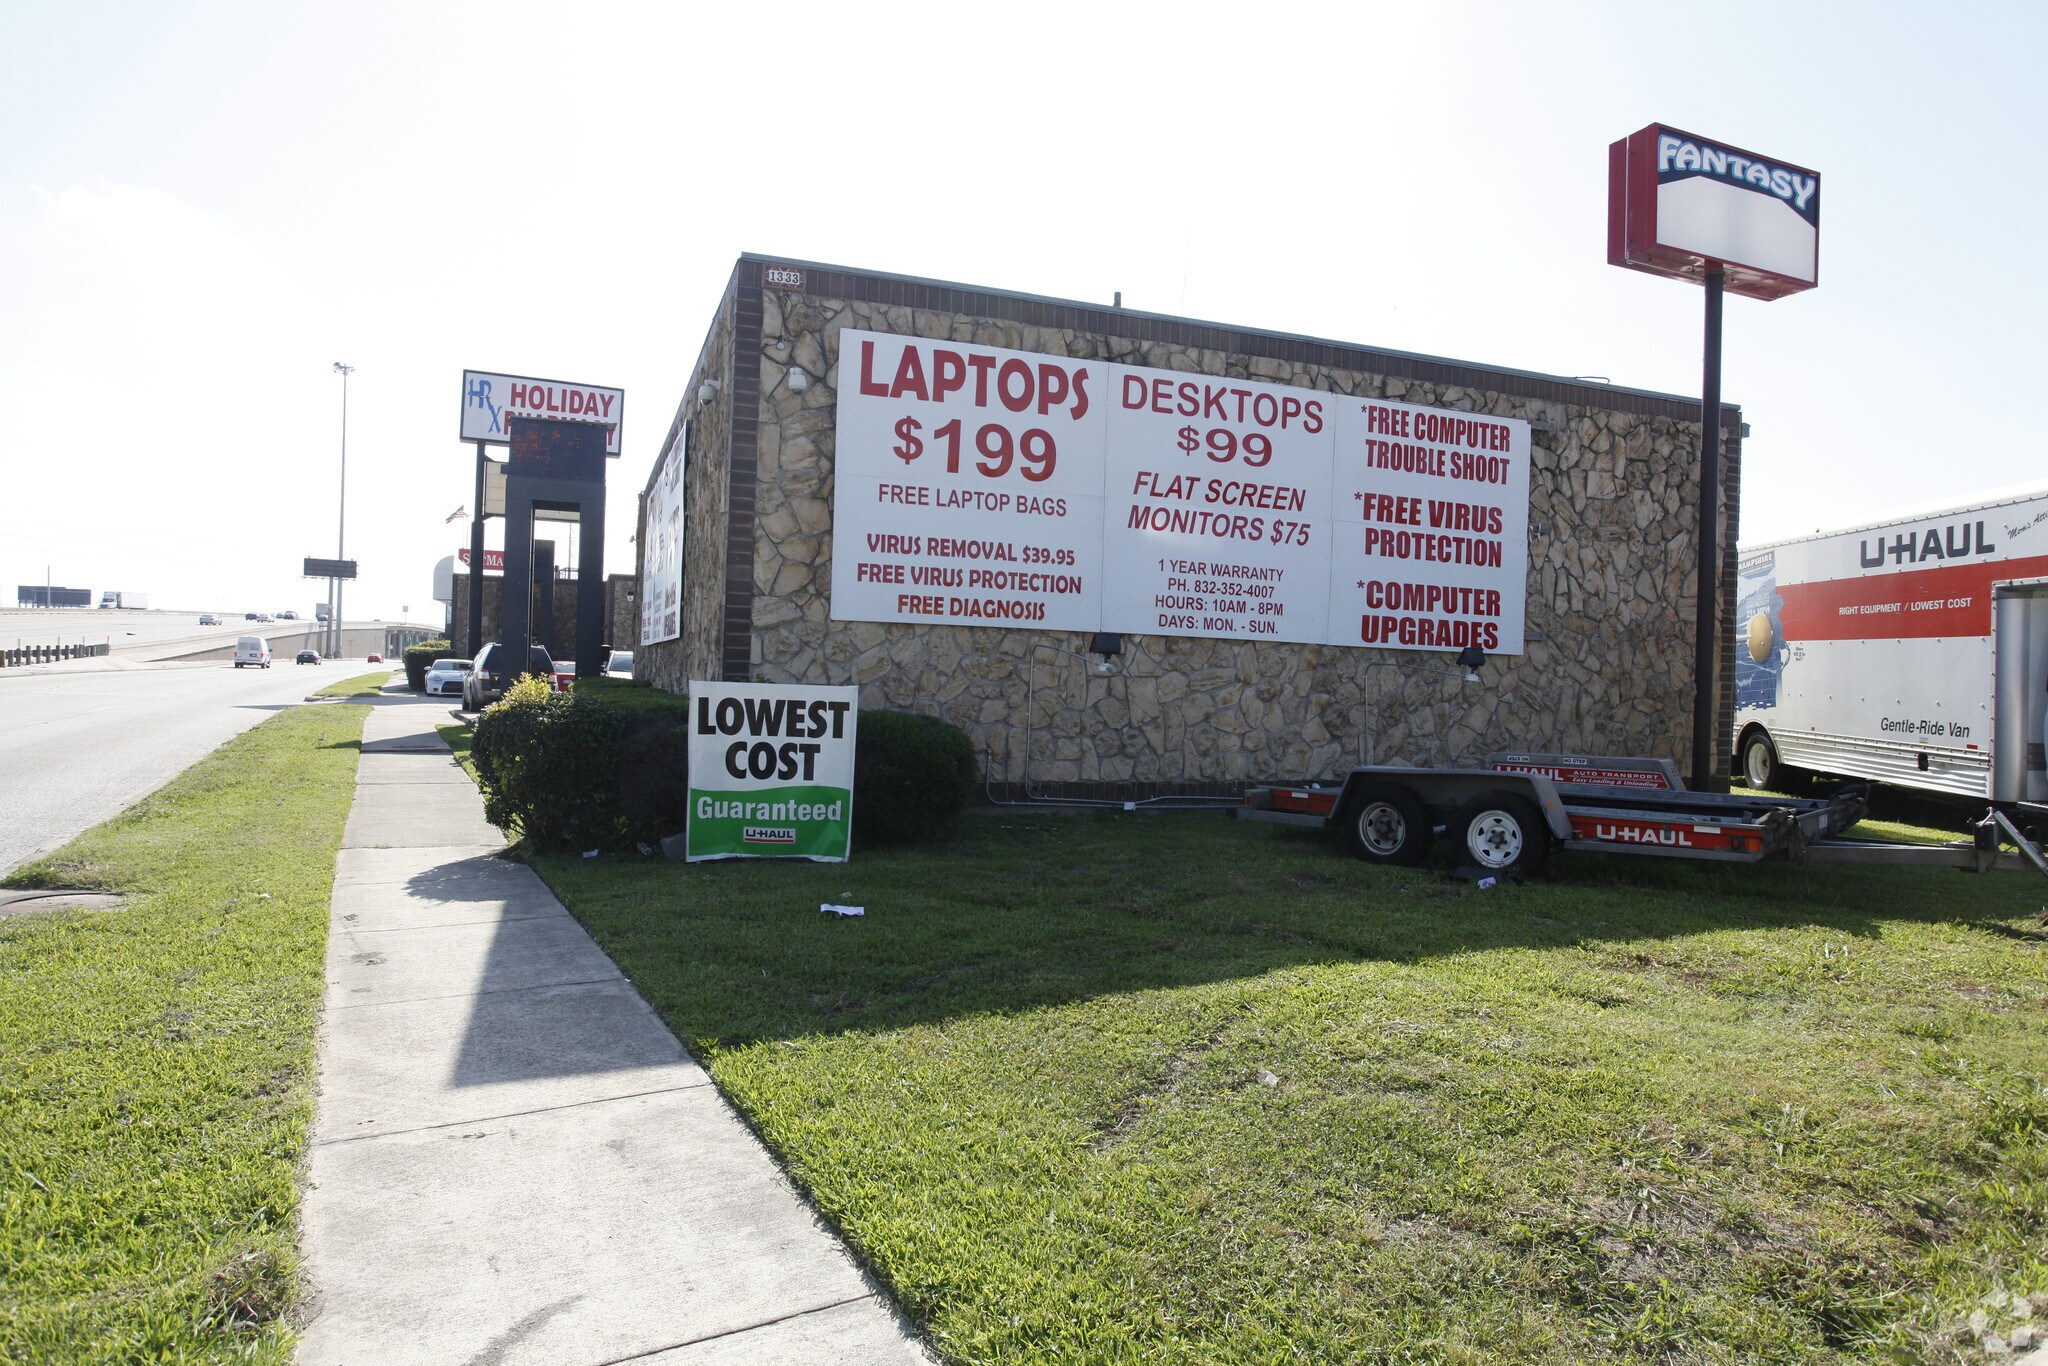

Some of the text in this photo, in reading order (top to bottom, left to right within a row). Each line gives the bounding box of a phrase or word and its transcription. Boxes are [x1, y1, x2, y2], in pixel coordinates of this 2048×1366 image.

[1658, 134, 1815, 211] FANTASY
[770, 272, 799, 284] 1333
[860, 340, 1089, 421] LAPTOPS
[510, 383, 615, 417] HOLIDAY
[1122, 374, 1323, 434] DESKTOPS
[893, 415, 1057, 482] $199
[1177, 425, 1273, 467] $99
[1414, 411, 1511, 453] COMPUTER
[1365, 439, 1510, 485] TROUBLE SHOOT
[878, 484, 1067, 517] FREE LAPTOP BAGS
[1133, 471, 1306, 512] FLAT SCREEN
[1128, 505, 1311, 546] MONITORS $75
[1428, 500, 1503, 535] VIRUS
[867, 533, 1075, 566] VIRUS REMOVAL $39.95
[1365, 527, 1502, 568] PROTECTION
[1860, 521, 1995, 568] U-HAUL
[2007, 521, 2031, 540] Mom's
[857, 563, 1082, 595] FREE VIRUS PROTECTION
[1158, 559, 1284, 582] 1 YEAR WARRANTY
[1168, 577, 1275, 598] PH. 832-352-4007
[897, 594, 1046, 621] FREE DIAGNOSIS
[1155, 595, 1208, 612] HOURS:
[1212, 598, 1247, 614] 10AM
[1258, 600, 1284, 616] 8PM
[1838, 605, 1859, 616] RIGHT
[1860, 602, 1901, 615] EQUIPMENT
[1910, 599, 1945, 611] LOWEST
[1947, 597, 1973, 609] COST
[1158, 614, 1199, 630] DAYS:
[1203, 617, 1238, 632] MON.
[1248, 619, 1279, 634] SUN.
[1361, 614, 1499, 650] UPGRADES
[698, 697, 850, 739] LOWEST
[1880, 717, 1970, 739] Gentle-Ride Van
[725, 741, 821, 781] COST
[1602, 772, 1659, 780] TRANSPORT
[1624, 780, 1659, 788] Unloading
[697, 796, 842, 822] Guaranteed
[745, 829, 793, 839] U-HAUL
[1596, 824, 1693, 847] U-HAUL
